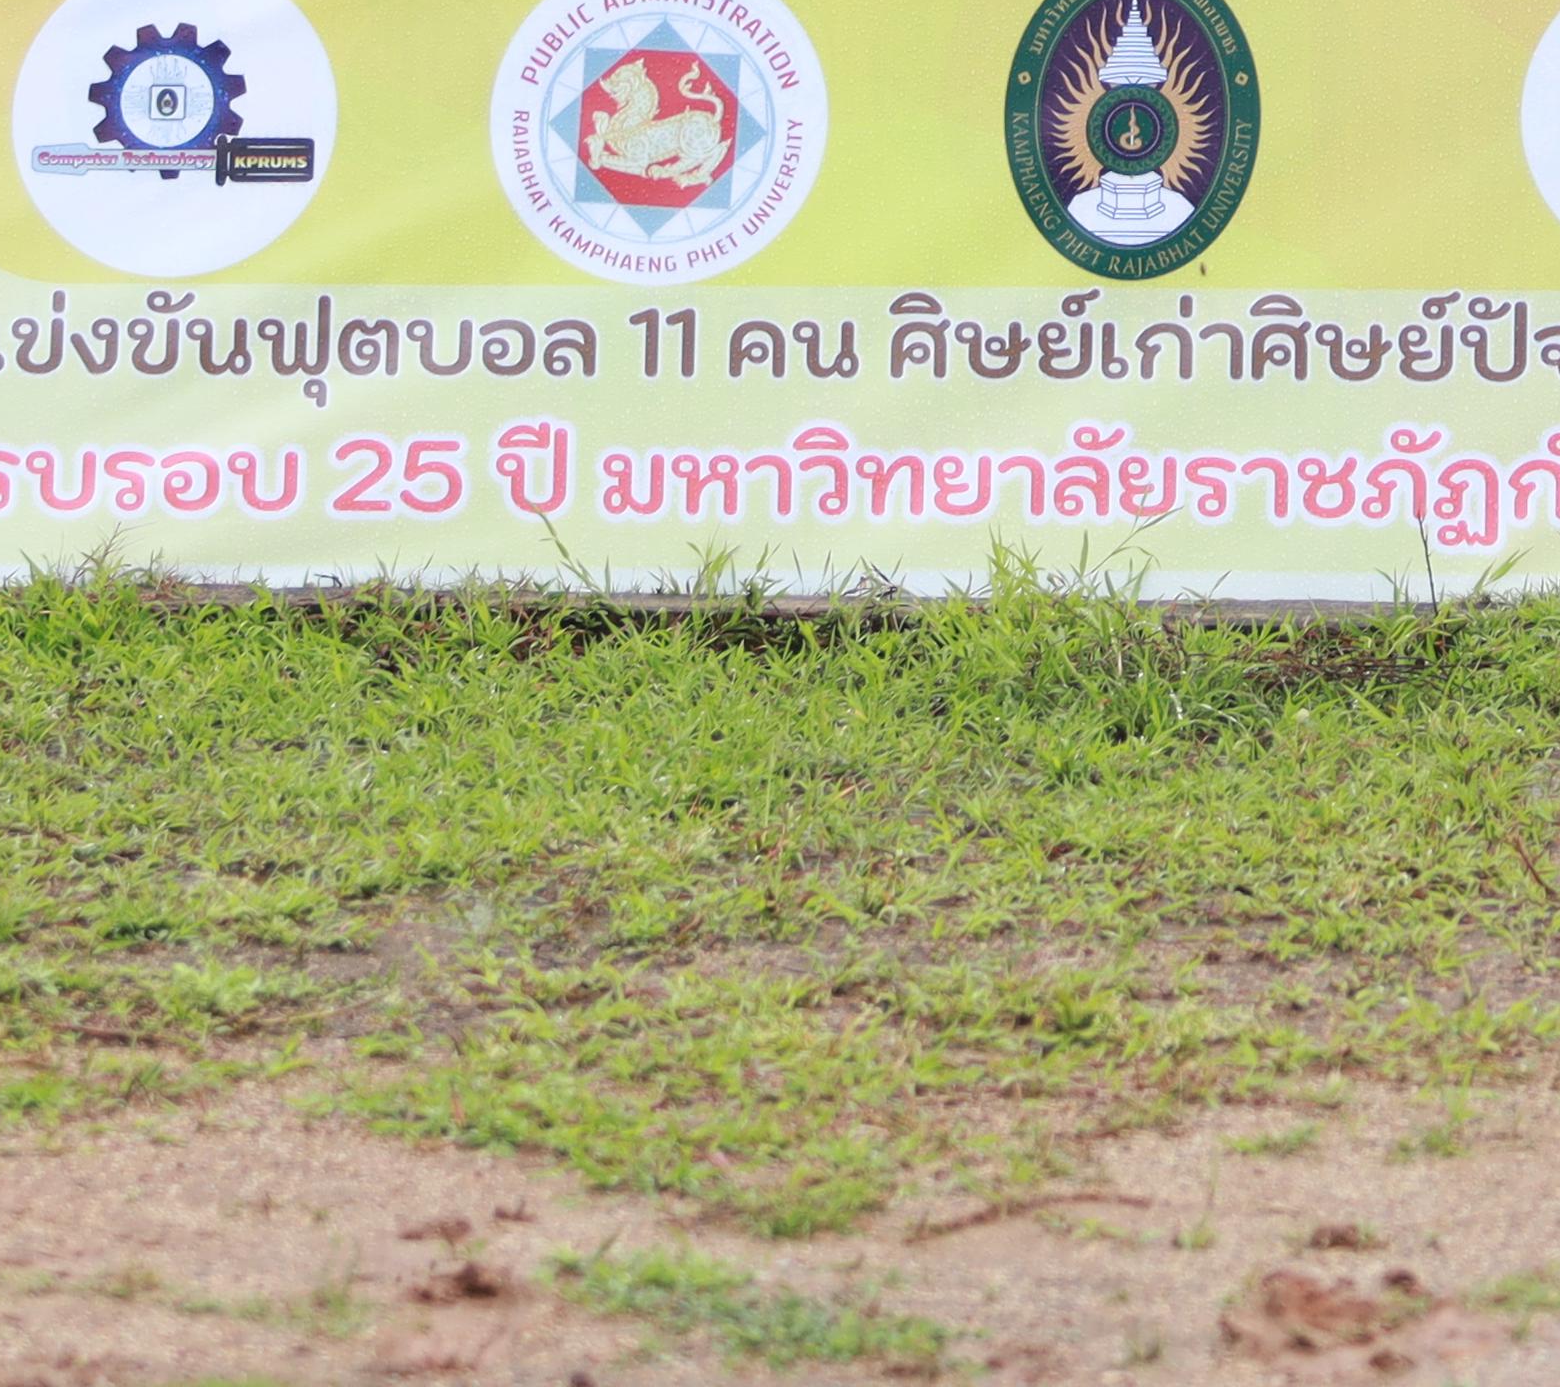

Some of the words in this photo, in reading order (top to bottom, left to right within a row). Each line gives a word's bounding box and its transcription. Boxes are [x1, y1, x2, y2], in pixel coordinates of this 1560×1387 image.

[521, 3, 595, 86] PUBLIC
[38, 151, 118, 167] Computer
[122, 151, 216, 169] Technology
[234, 155, 308, 169] KPRUMS
[548, 215, 677, 272] KAMPHAENG
[687, 233, 739, 268] PHET
[742, 119, 803, 236] UNIVERSITY
[1012, 112, 1064, 230] KAMPHAENG
[1056, 229, 1104, 267] PHET
[1107, 227, 1206, 276] RAJABHAT
[1202, 119, 1252, 233] UNIVERSITY
[636, 308, 697, 378] 11
[729, 319, 859, 379] คน
[333, 438, 463, 513] 25
[495, 421, 569, 511] ปี
